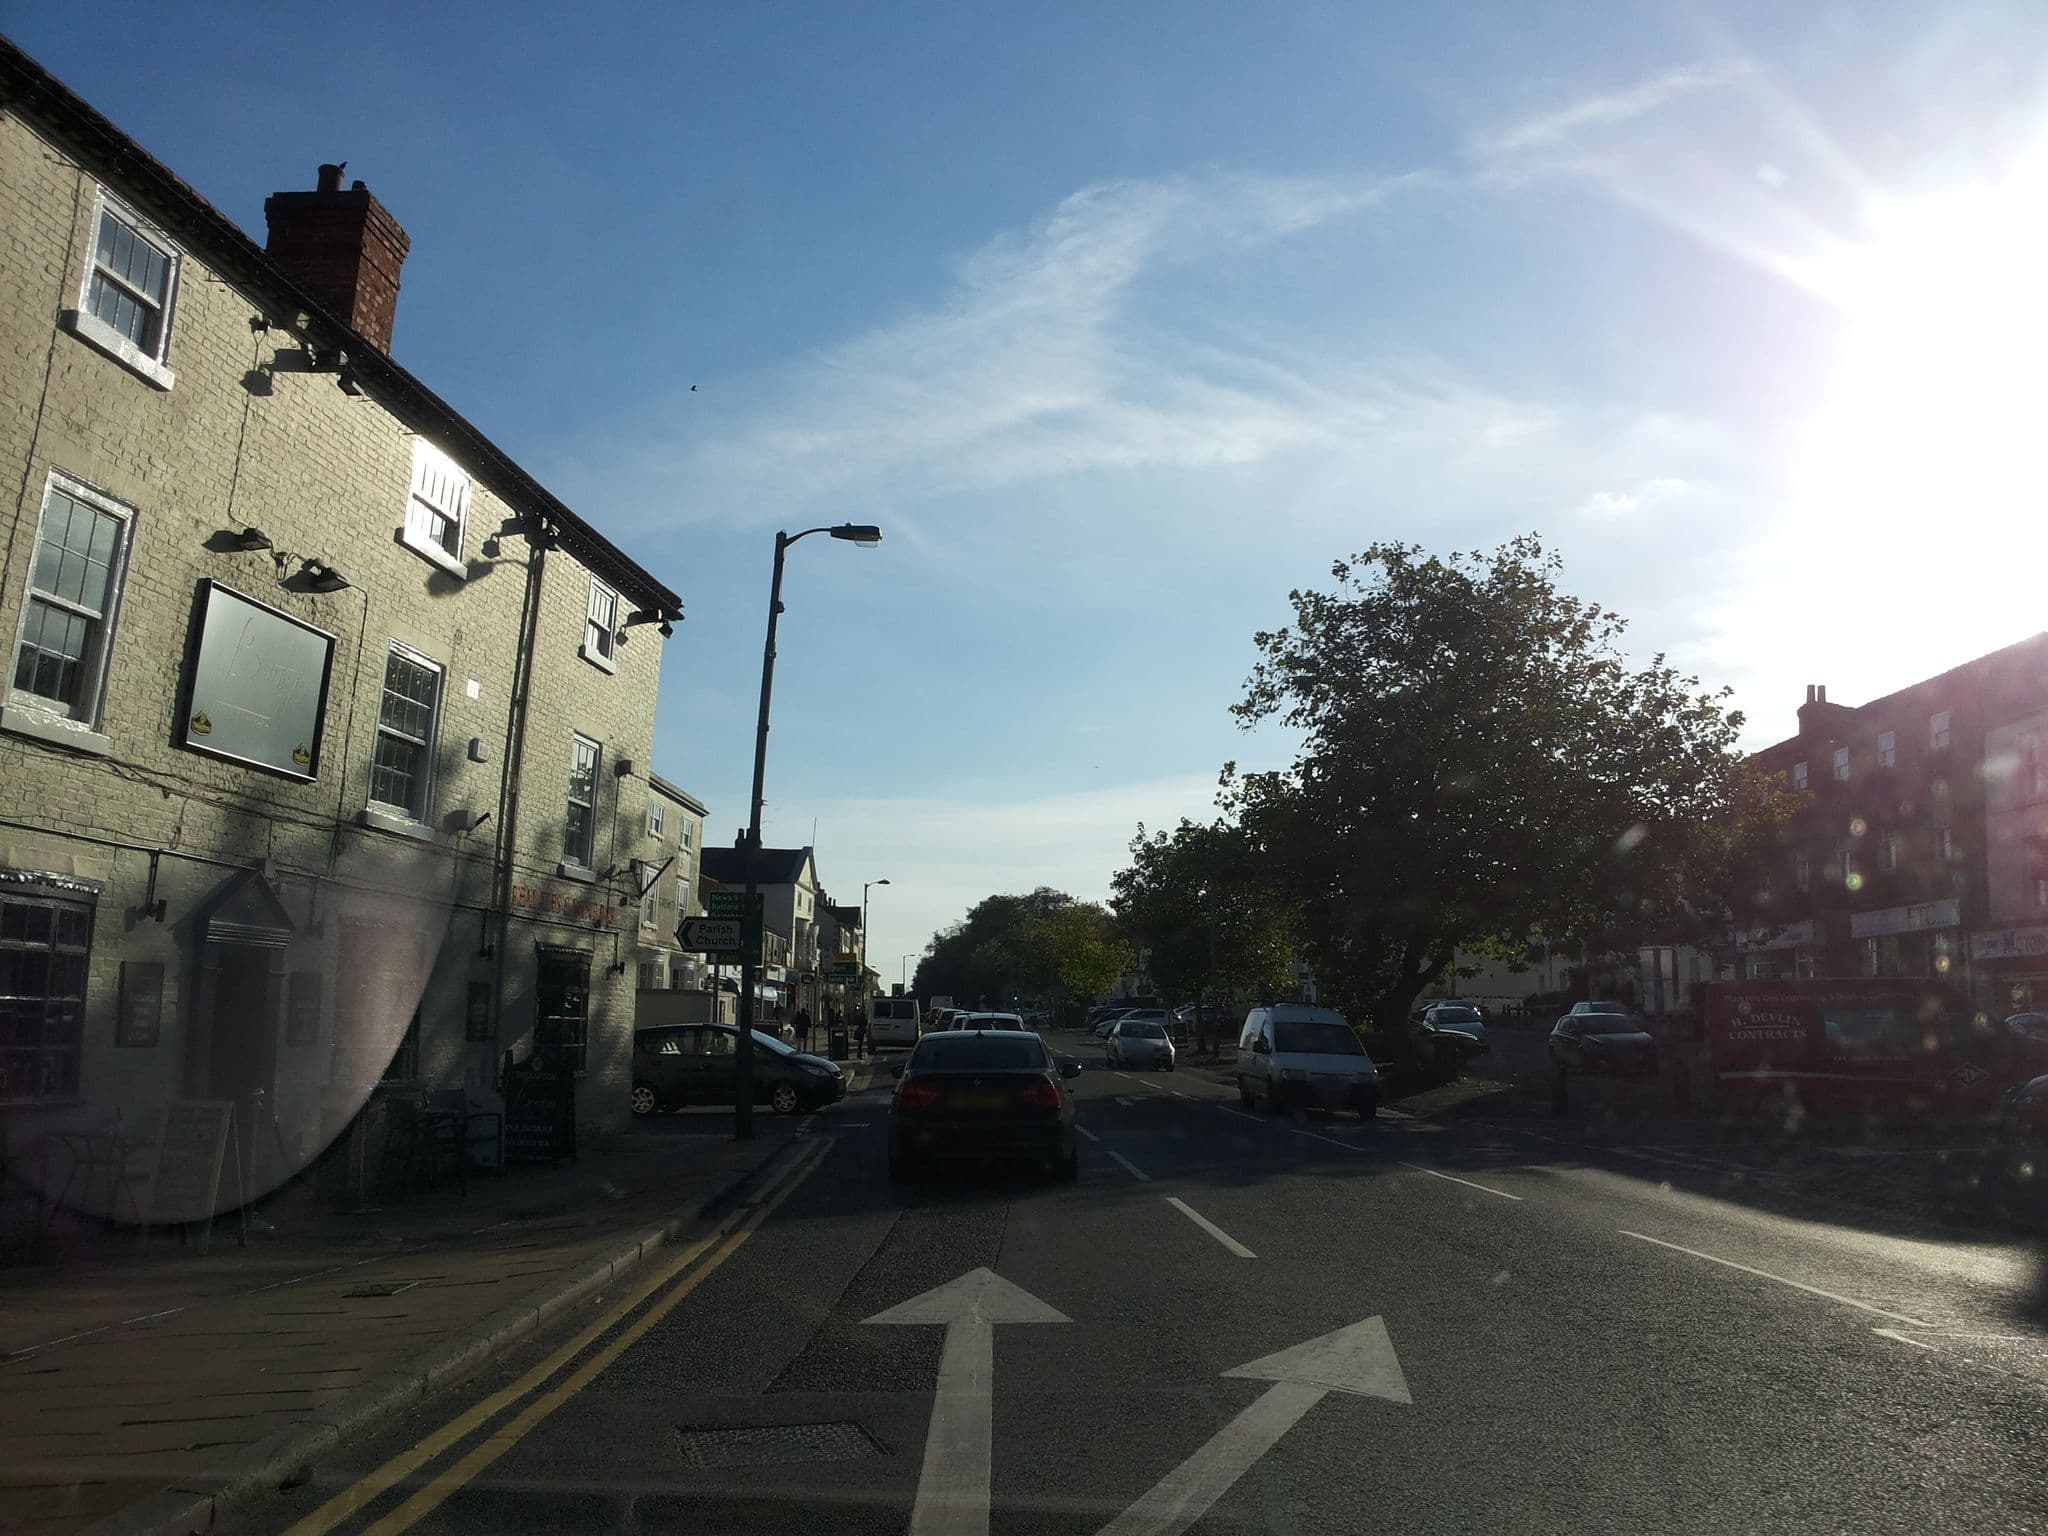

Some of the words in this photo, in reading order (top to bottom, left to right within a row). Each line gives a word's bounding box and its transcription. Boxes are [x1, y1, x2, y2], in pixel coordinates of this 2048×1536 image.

[699, 924, 733, 935] Parish
[695, 936, 736, 946] Church
[1731, 1017, 1746, 1028] H.
[1750, 1013, 1801, 1026] DEVLIN
[1728, 1030, 1807, 1041] CONTRACTS
